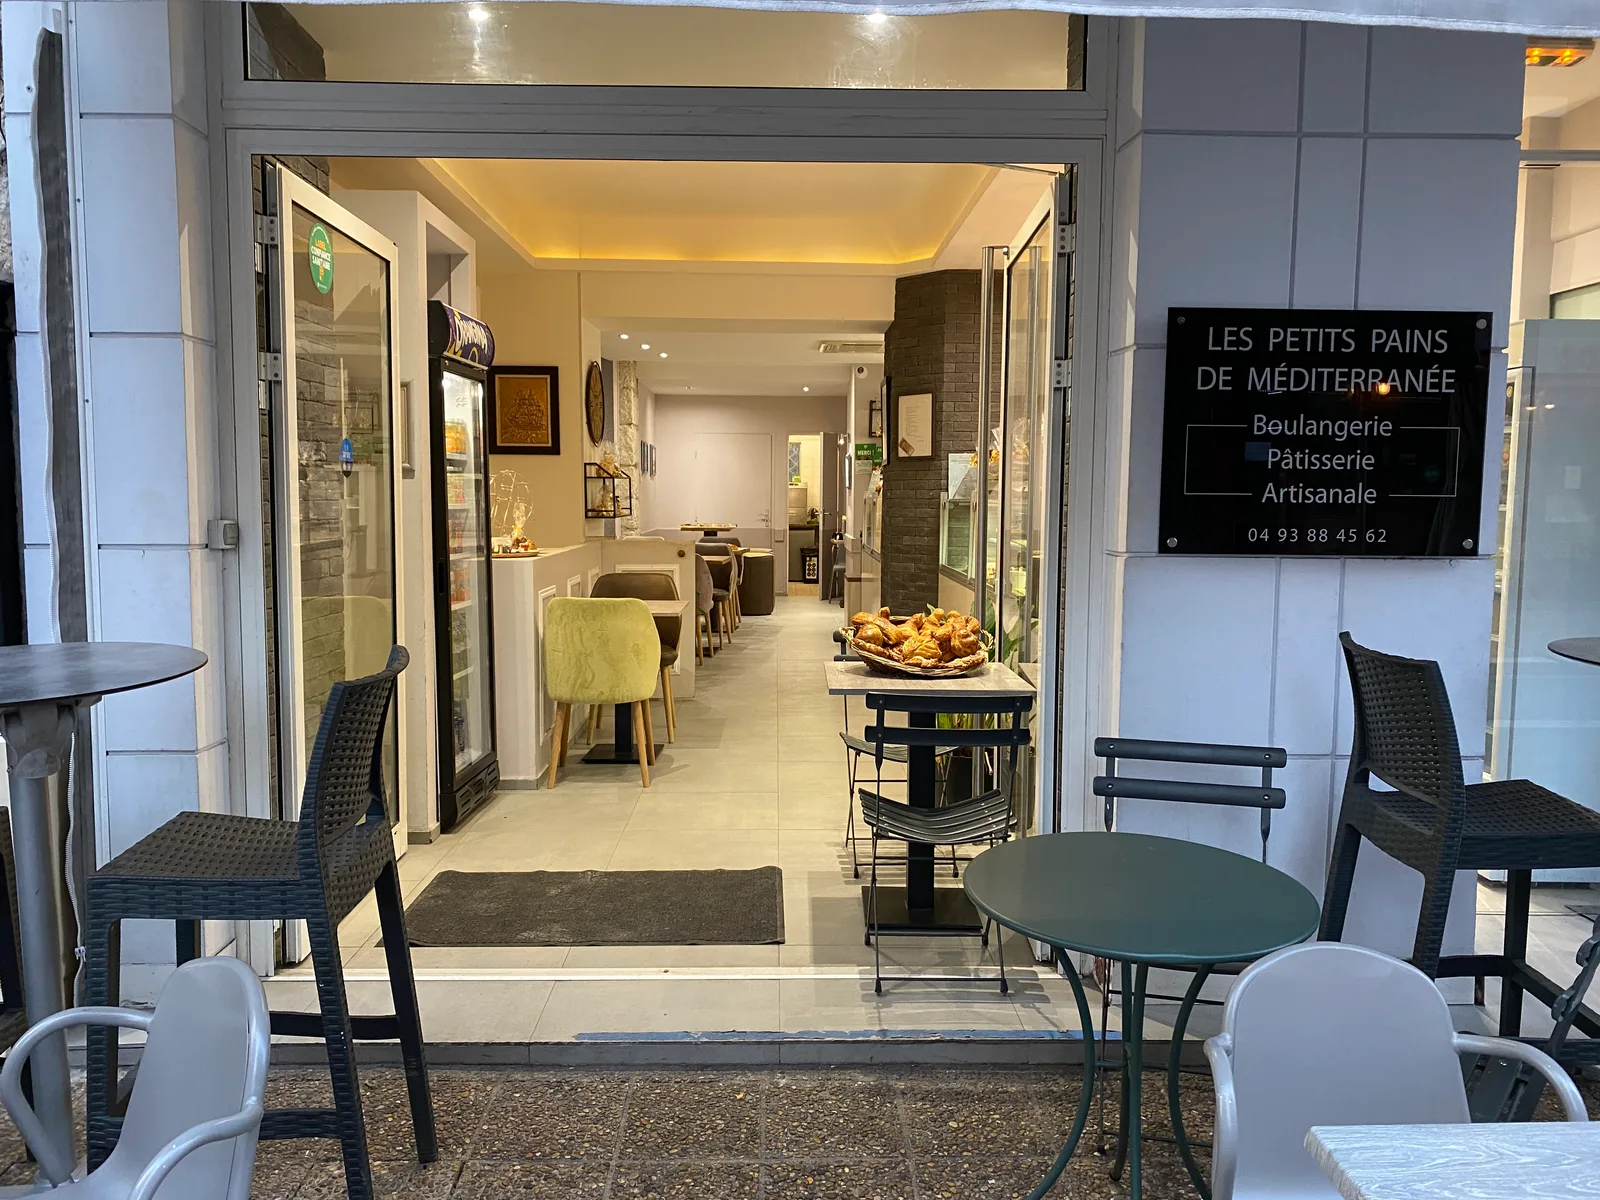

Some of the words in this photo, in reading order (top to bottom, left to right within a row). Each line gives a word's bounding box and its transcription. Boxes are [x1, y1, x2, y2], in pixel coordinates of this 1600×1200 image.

[1209, 327, 1252, 350] LES
[1270, 328, 1354, 352] PETITS
[1372, 330, 1447, 353] PAINS
[1198, 367, 1232, 389] DE
[1247, 363, 1456, 395] MÉDITERRANÉE
[1254, 414, 1392, 441] Boulangerie
[1267, 449, 1375, 471] Pâtisserie
[1262, 483, 1376, 503] Artisanale
[1249, 528, 1269, 541] 04
[1278, 529, 1297, 541] 93
[1308, 529, 1327, 542] 88
[1336, 529, 1356, 542] 45
[1366, 530, 1385, 542] 62
